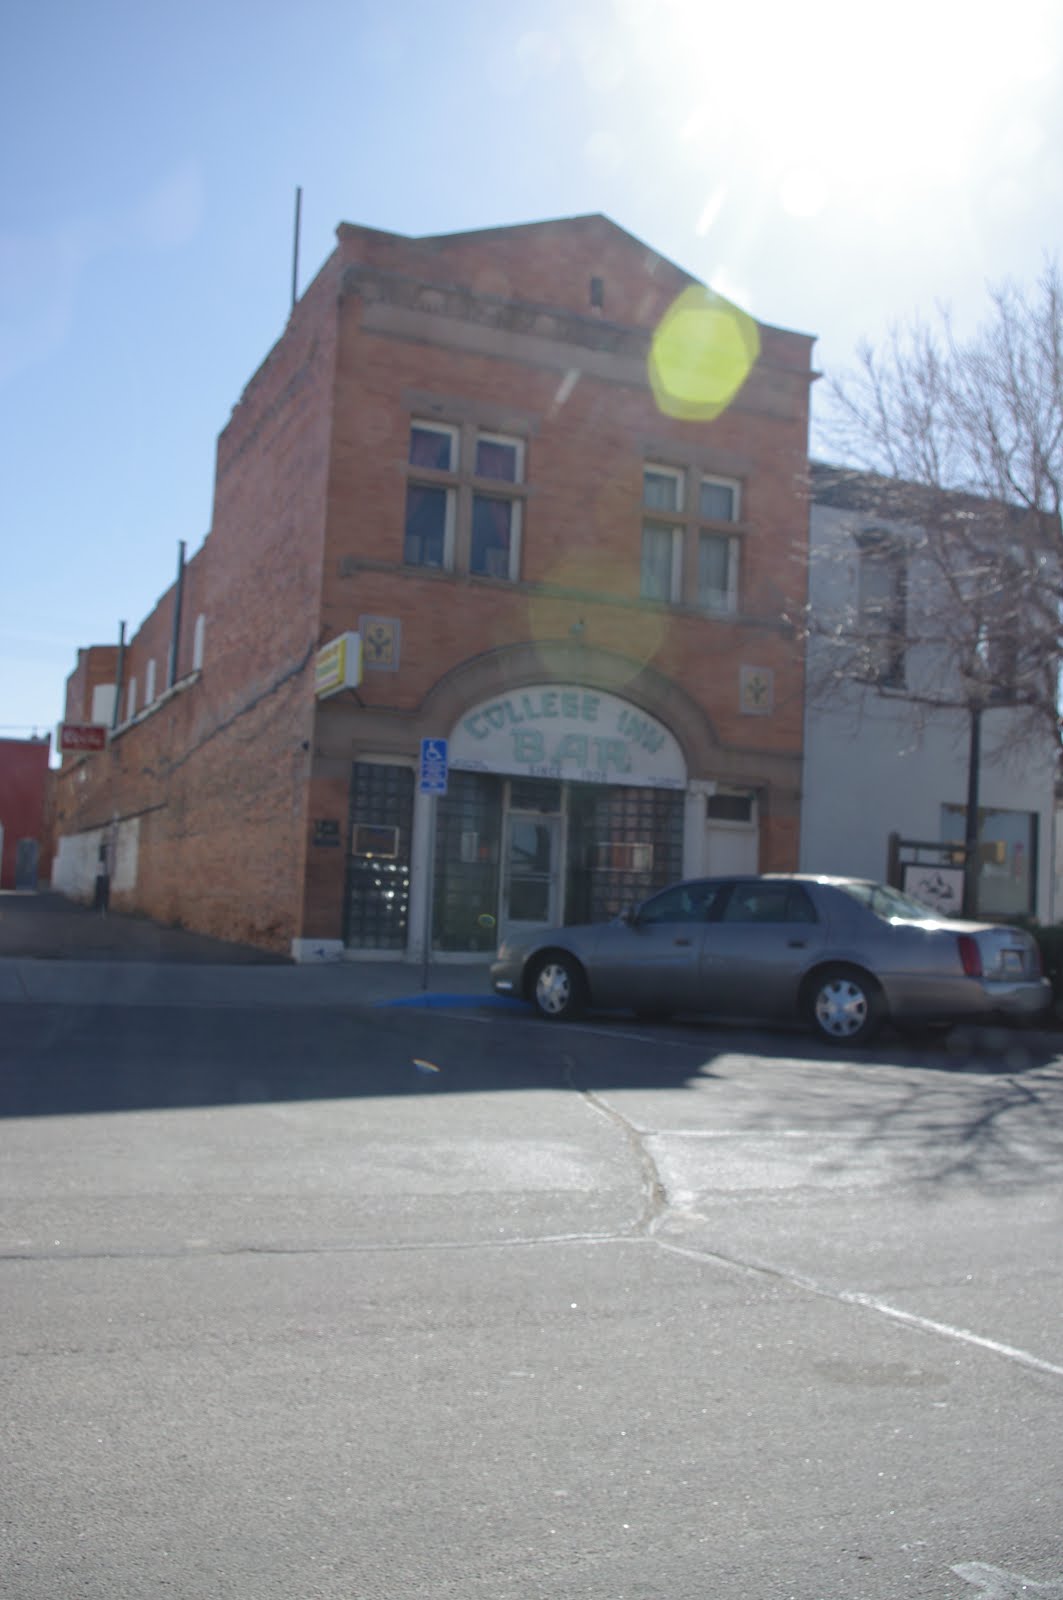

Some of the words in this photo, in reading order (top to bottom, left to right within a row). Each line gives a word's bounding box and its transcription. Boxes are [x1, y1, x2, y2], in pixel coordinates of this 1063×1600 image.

[463, 692, 600, 741] COLLEGE
[616, 709, 666, 754] INN
[511, 728, 632, 774] BAR
